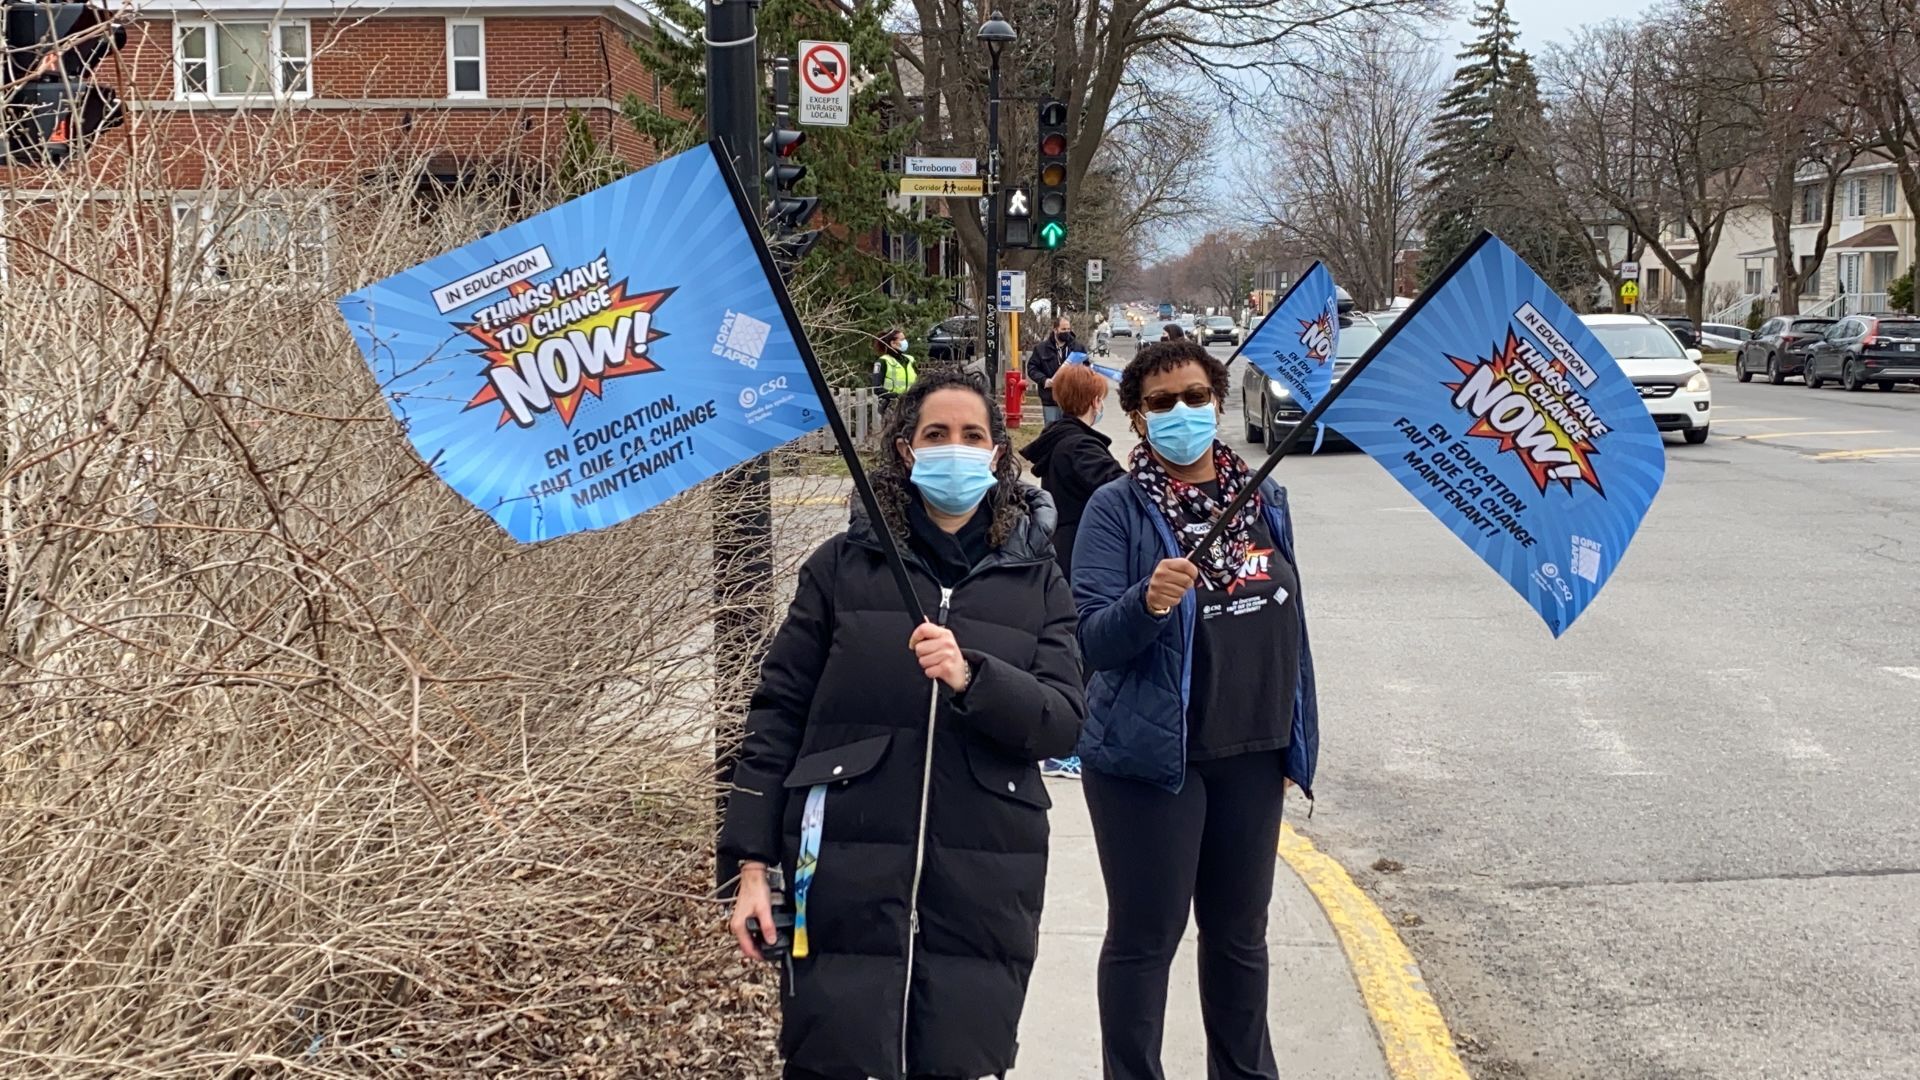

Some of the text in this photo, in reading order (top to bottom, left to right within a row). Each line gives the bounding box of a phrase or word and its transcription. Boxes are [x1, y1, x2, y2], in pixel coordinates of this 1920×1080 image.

[806, 104, 843, 113] LIVRAISON
[911, 163, 957, 172] Terrebonne
[445, 256, 539, 304] IN EDUCATION
[474, 256, 610, 330] THINGS HAVE
[495, 285, 613, 350] TO CHANGE
[1524, 312, 1588, 376] IN EDUCATION
[490, 311, 651, 424] NOW!
[722, 348, 758, 370] APEQ
[759, 375, 788, 396] CSQ
[1272, 350, 1305, 379] FAUT QUE
[1288, 352, 1300, 363] EN
[1516, 338, 1608, 438] THINGS HAVE
[544, 394, 681, 470] EN ÉDUCATION,
[1455, 363, 1581, 480] NOW!
[1507, 359, 1589, 443] TO CHANGE
[528, 468, 573, 501] FAUT
[579, 449, 614, 479] QUE
[620, 435, 648, 465] ÇA
[650, 400, 718, 447] CHANGE
[1393, 416, 1538, 549] FAUT QUE ÇA CHANGE
[1428, 423, 1527, 518] EN ÉDUCATION,
[1555, 577, 1573, 602] CSQ
